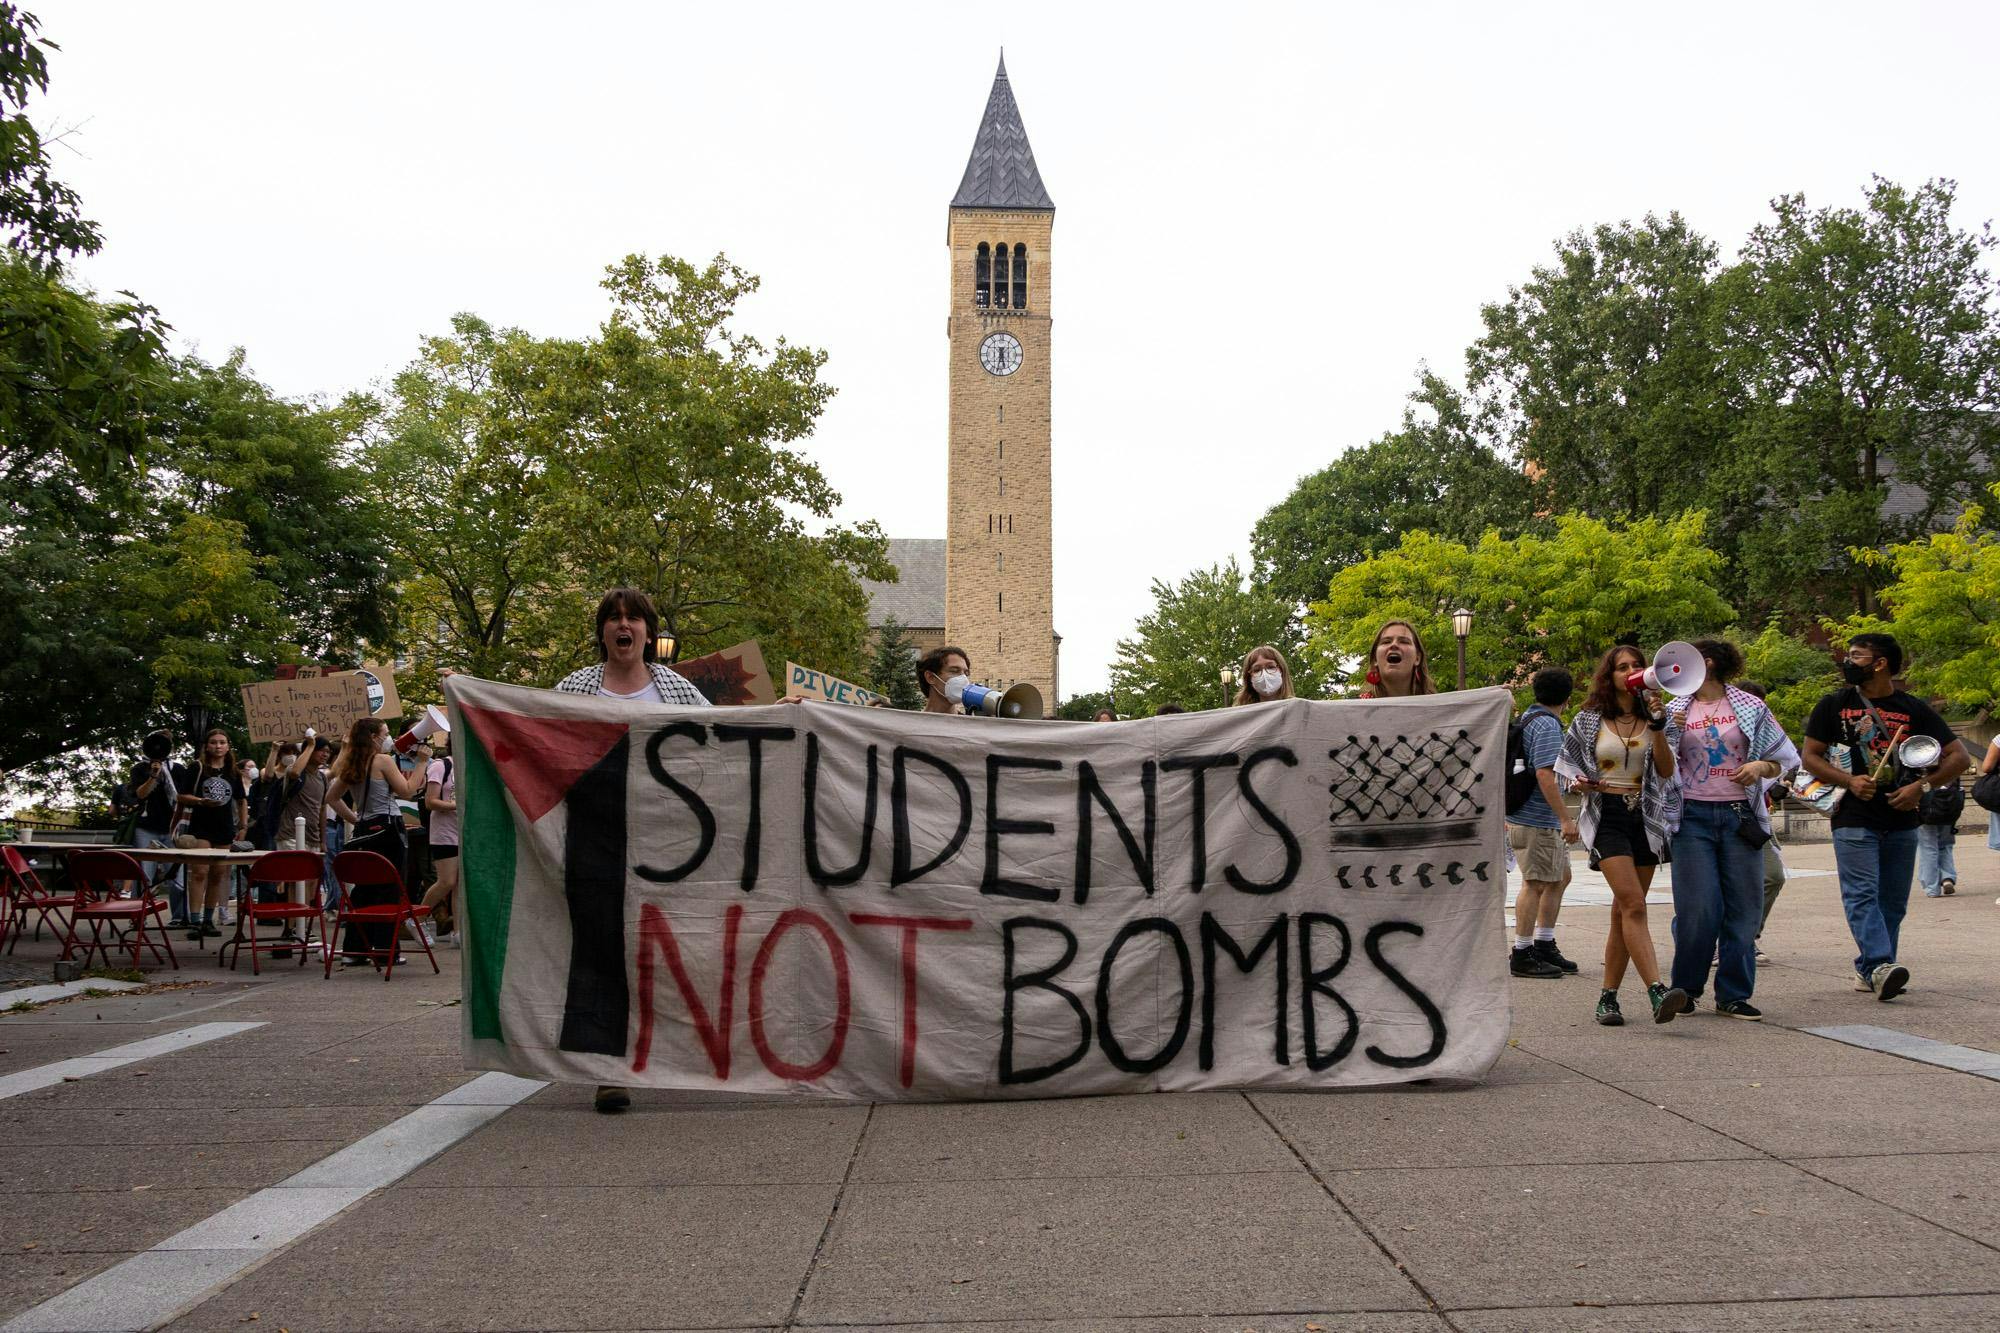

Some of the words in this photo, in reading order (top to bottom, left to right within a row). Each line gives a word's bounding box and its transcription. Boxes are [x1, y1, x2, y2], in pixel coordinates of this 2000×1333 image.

[241, 684, 281, 705] The
[314, 690, 322, 698] is
[792, 667, 879, 705] DIVES
[250, 706, 285, 719] choice
[290, 707, 301, 718] is
[1686, 719, 1710, 731] NEE
[1711, 715, 1736, 726] RAP
[251, 718, 292, 737] funds
[318, 713, 338, 733] Big
[1710, 768, 1734, 777] BITE
[633, 721, 1302, 904] STUDENTS
[631, 903, 973, 1089] NOT
[999, 911, 1447, 1084] BOMBS
